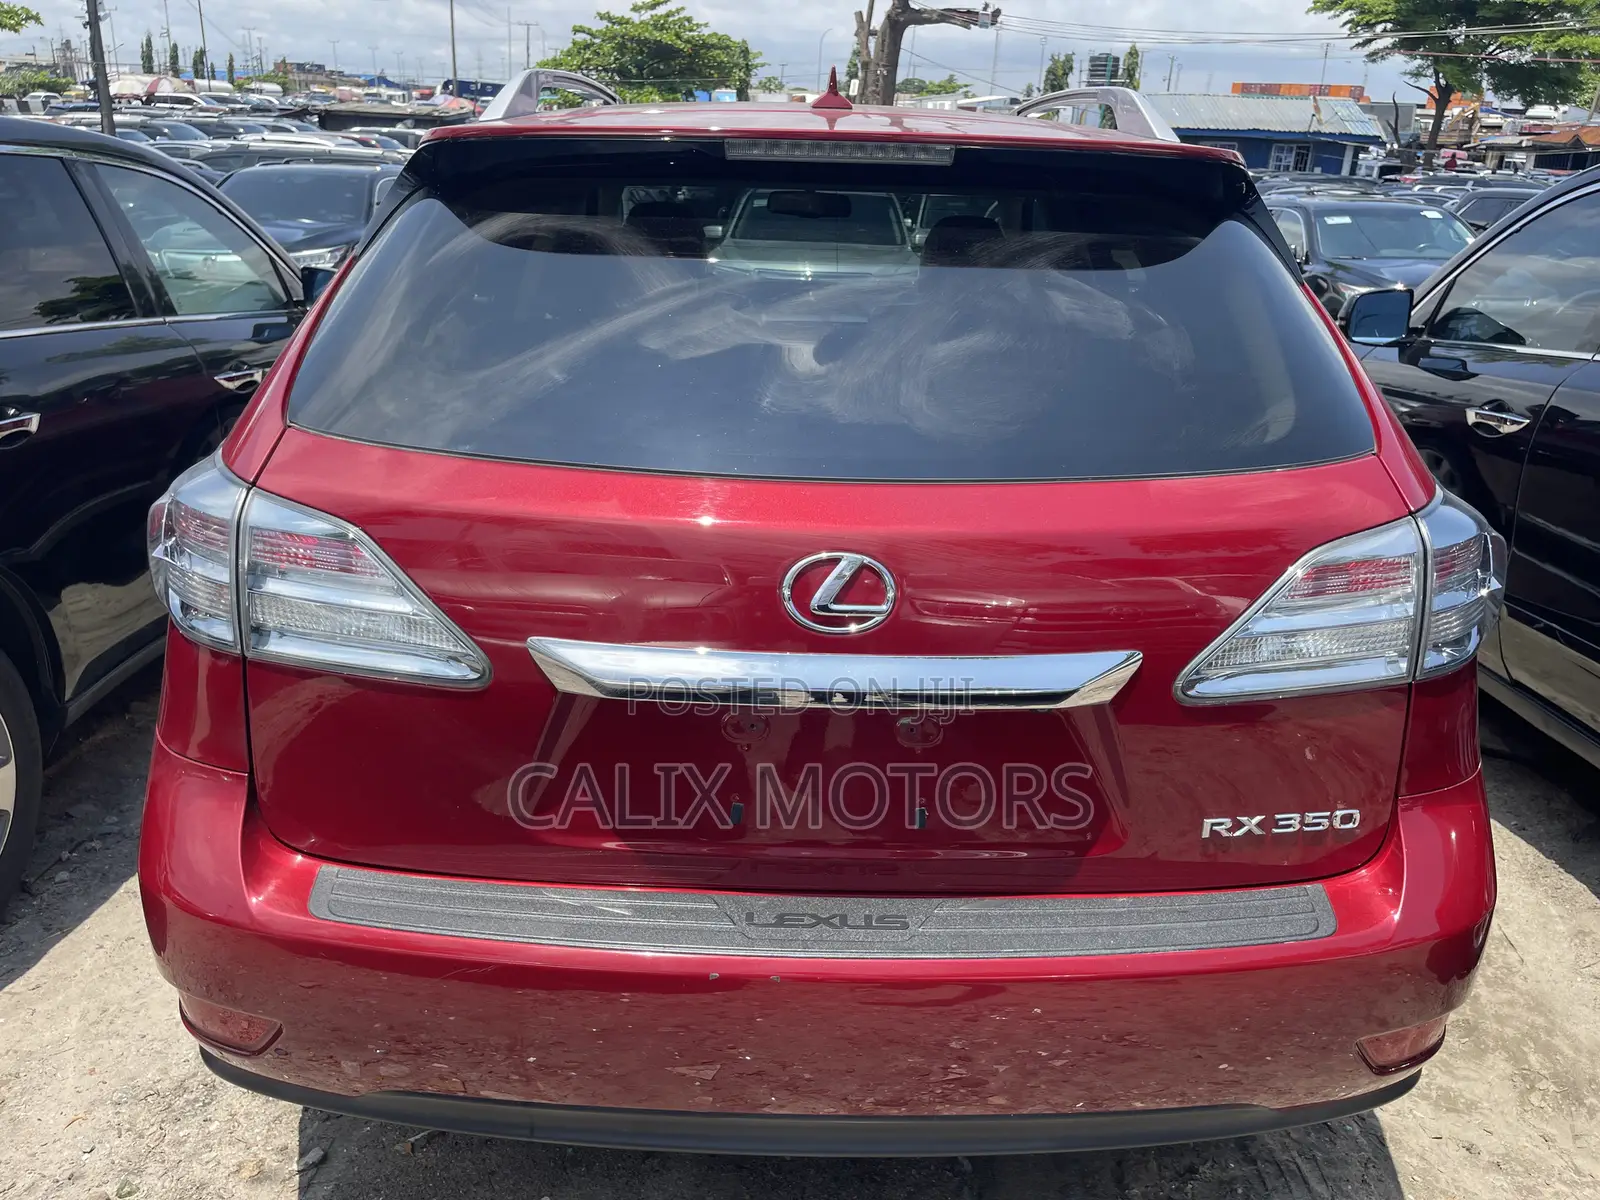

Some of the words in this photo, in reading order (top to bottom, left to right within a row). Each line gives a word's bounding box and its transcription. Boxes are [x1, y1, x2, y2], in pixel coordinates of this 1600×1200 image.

[1201, 815, 1266, 839] RX
[1271, 809, 1361, 834] 350
[744, 911, 910, 931] LEXUS
